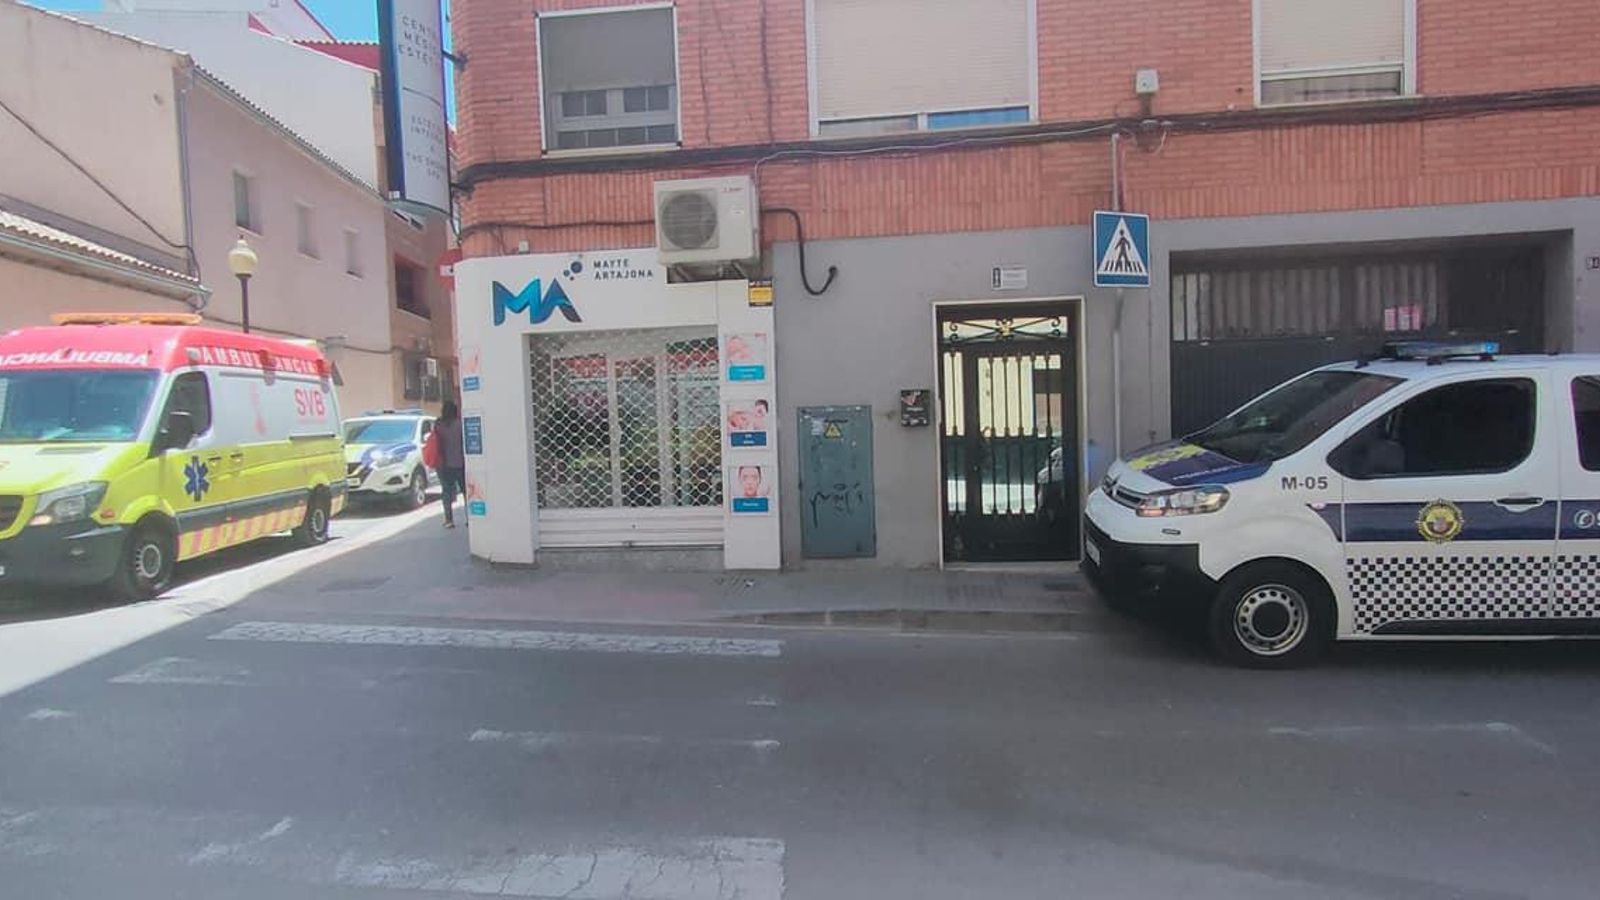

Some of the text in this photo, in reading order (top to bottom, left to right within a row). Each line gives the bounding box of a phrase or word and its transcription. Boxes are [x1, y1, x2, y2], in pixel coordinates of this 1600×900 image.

[593, 259, 629, 269] MAYTE
[594, 270, 653, 280] ARTAJONA
[492, 278, 583, 326] MA
[294, 388, 326, 416] SVB
[1281, 476, 1328, 490] M-05
